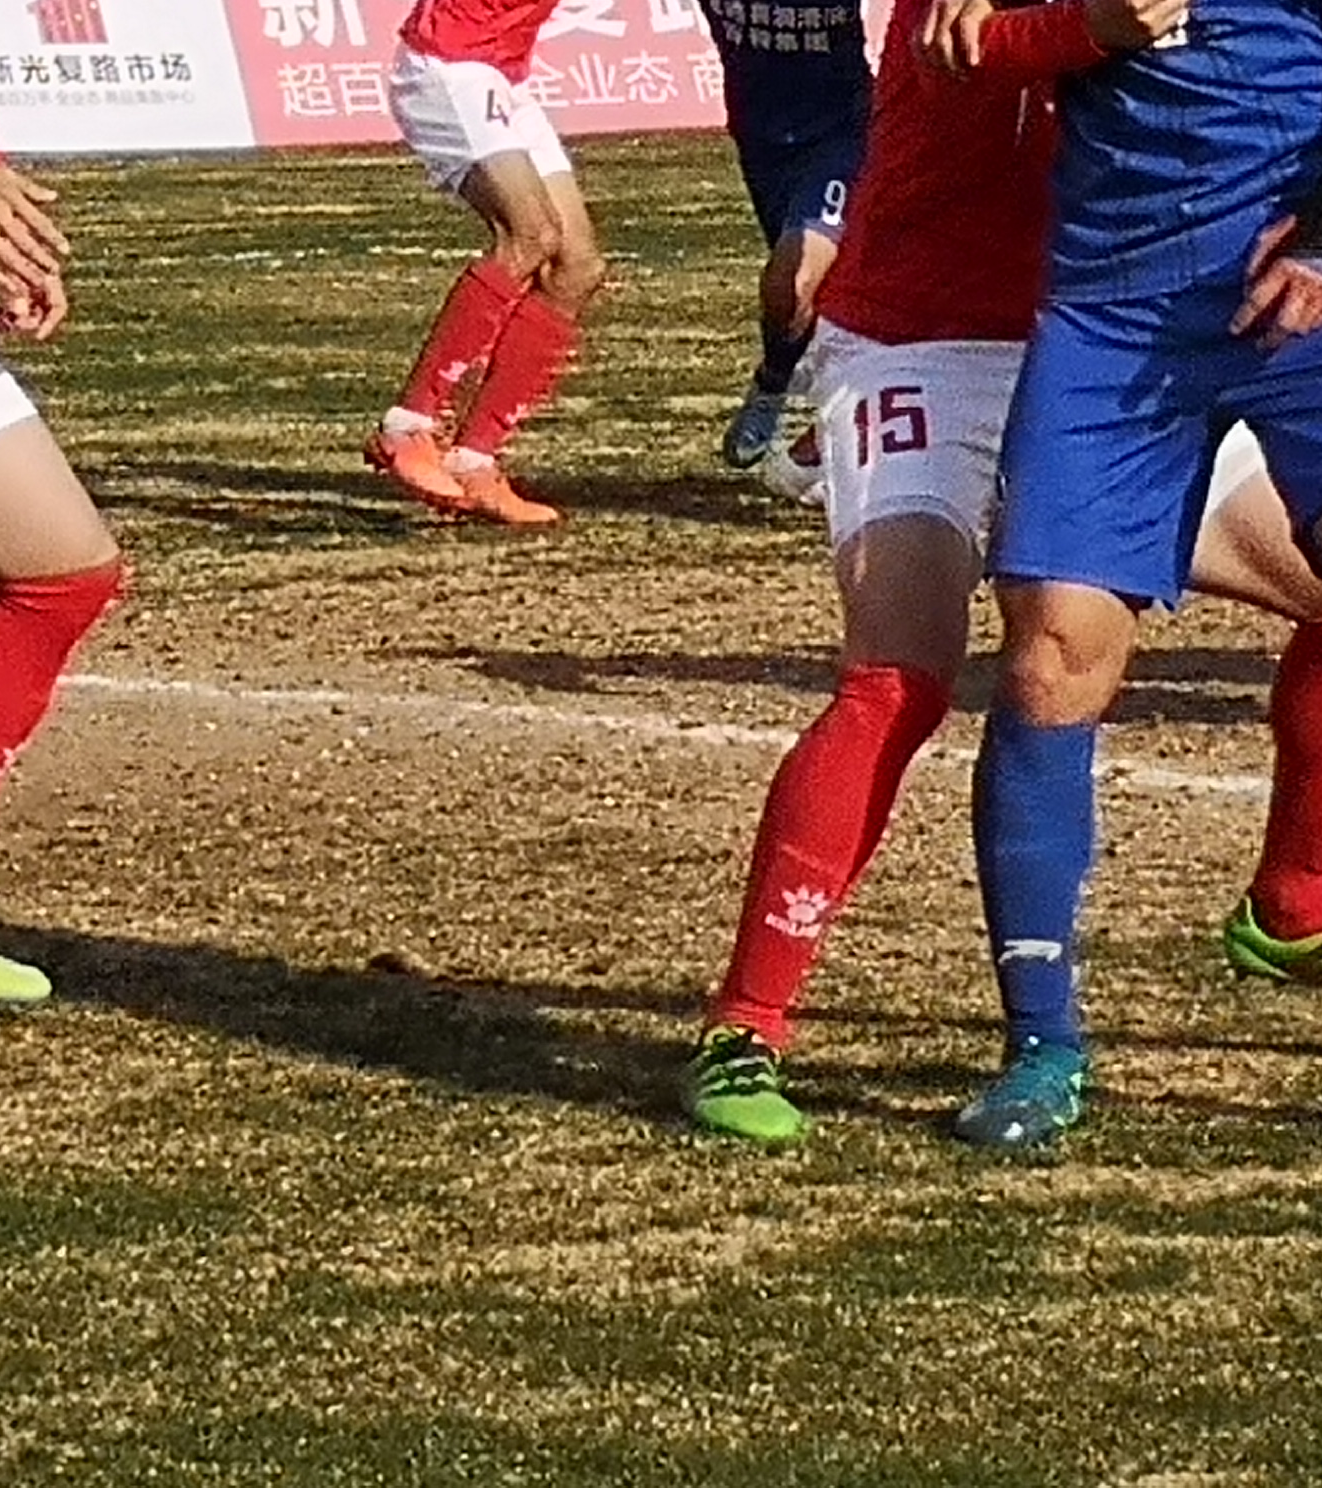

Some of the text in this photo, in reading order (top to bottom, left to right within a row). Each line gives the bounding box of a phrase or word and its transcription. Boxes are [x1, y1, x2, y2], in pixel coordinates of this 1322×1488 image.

[485, 88, 509, 127] 4
[821, 179, 847, 227] 9
[853, 385, 928, 468] 15
